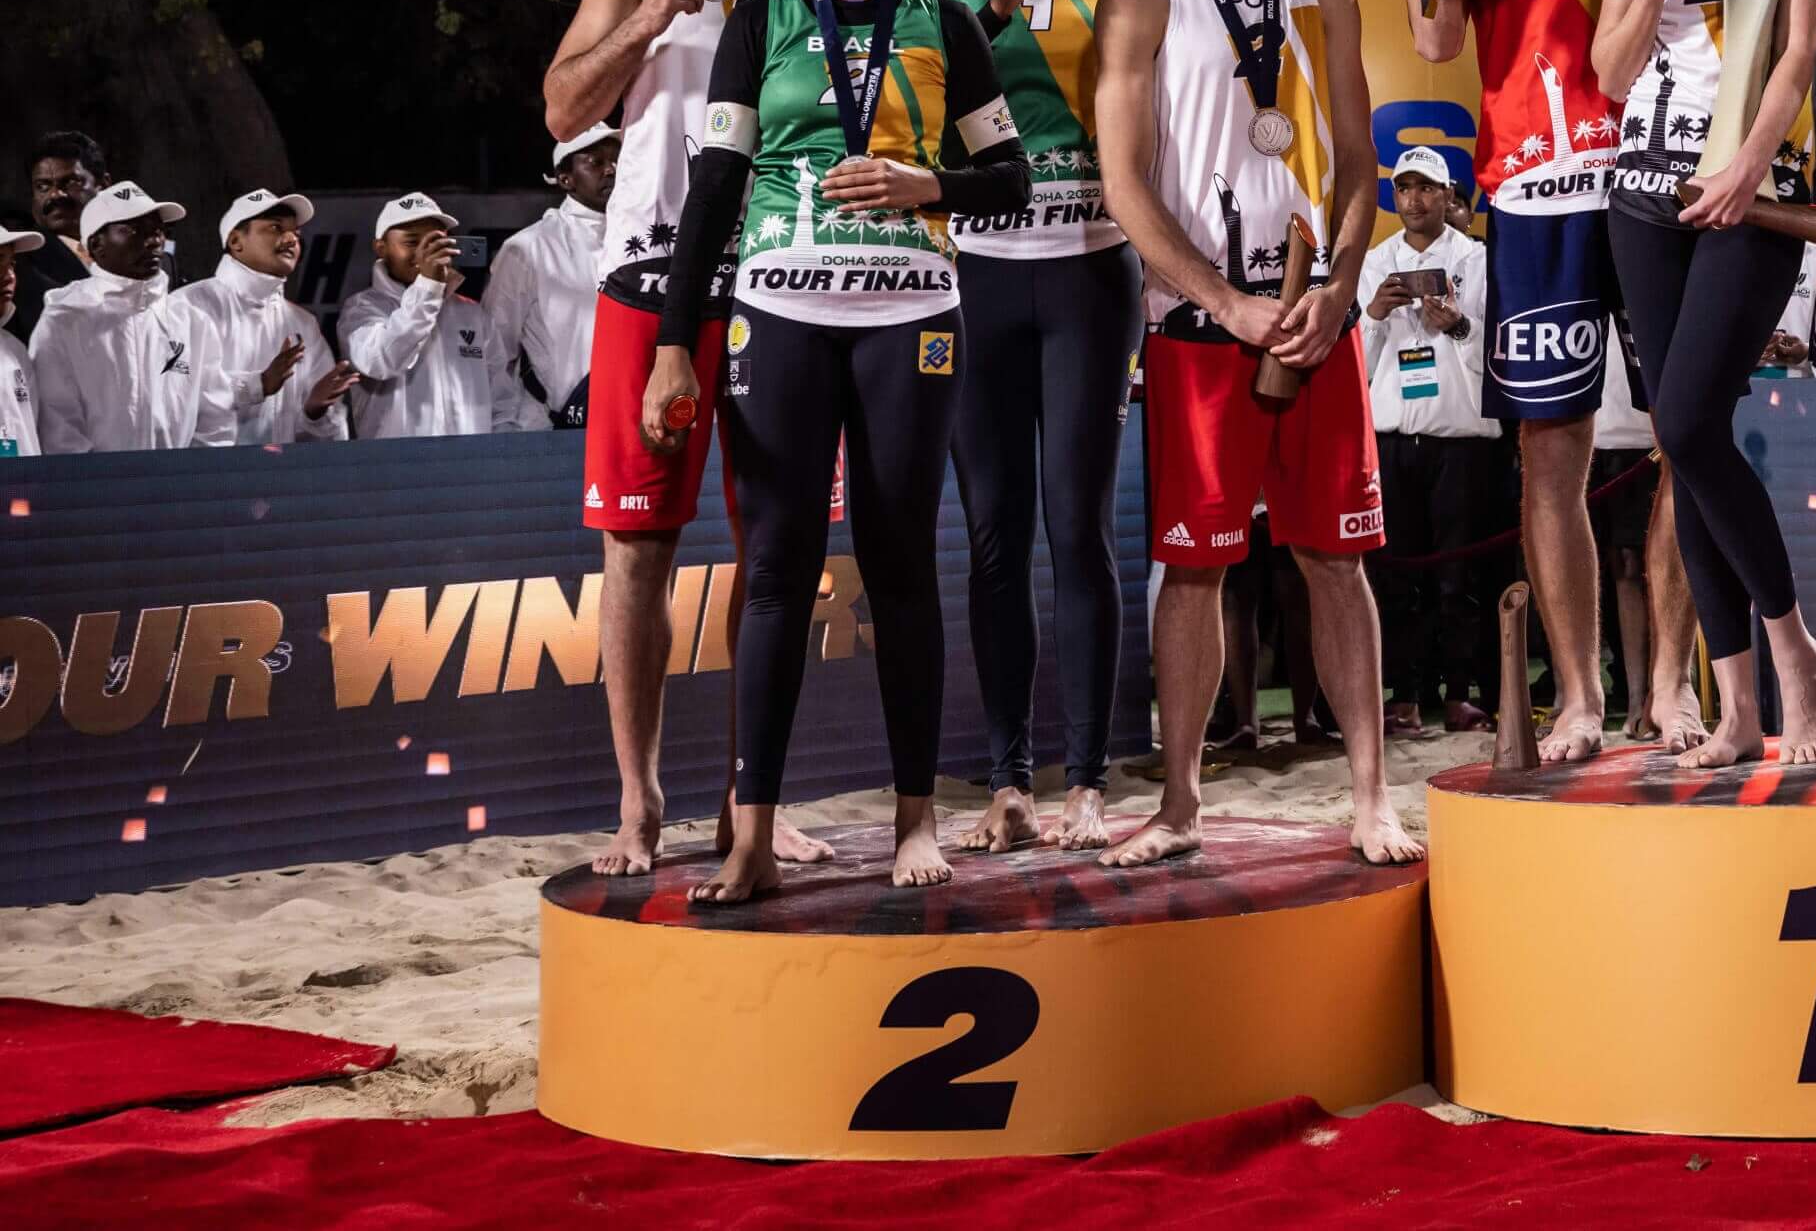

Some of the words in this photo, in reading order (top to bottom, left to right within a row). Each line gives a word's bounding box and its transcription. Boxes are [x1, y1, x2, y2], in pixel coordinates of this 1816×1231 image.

[807, 36, 905, 54] BASL
[1670, 160, 1698, 173] DOH
[1520, 171, 1595, 200] TOUR
[1612, 167, 1678, 195] TOUR
[1031, 191, 1064, 204] OHA
[1067, 187, 1101, 200] 2022
[953, 206, 1037, 236] TOUR
[1042, 199, 1106, 227] FINA
[821, 256, 865, 267] DOHA
[870, 256, 911, 267] 2022
[749, 268, 833, 291] TOUR
[840, 269, 953, 292] FINALS
[620, 495, 650, 510] BRYL
[1344, 513, 1384, 535] ORL
[1163, 535, 1196, 548] adidas
[1211, 529, 1245, 548] ŁOSIAK
[848, 967, 1040, 1131] 2
